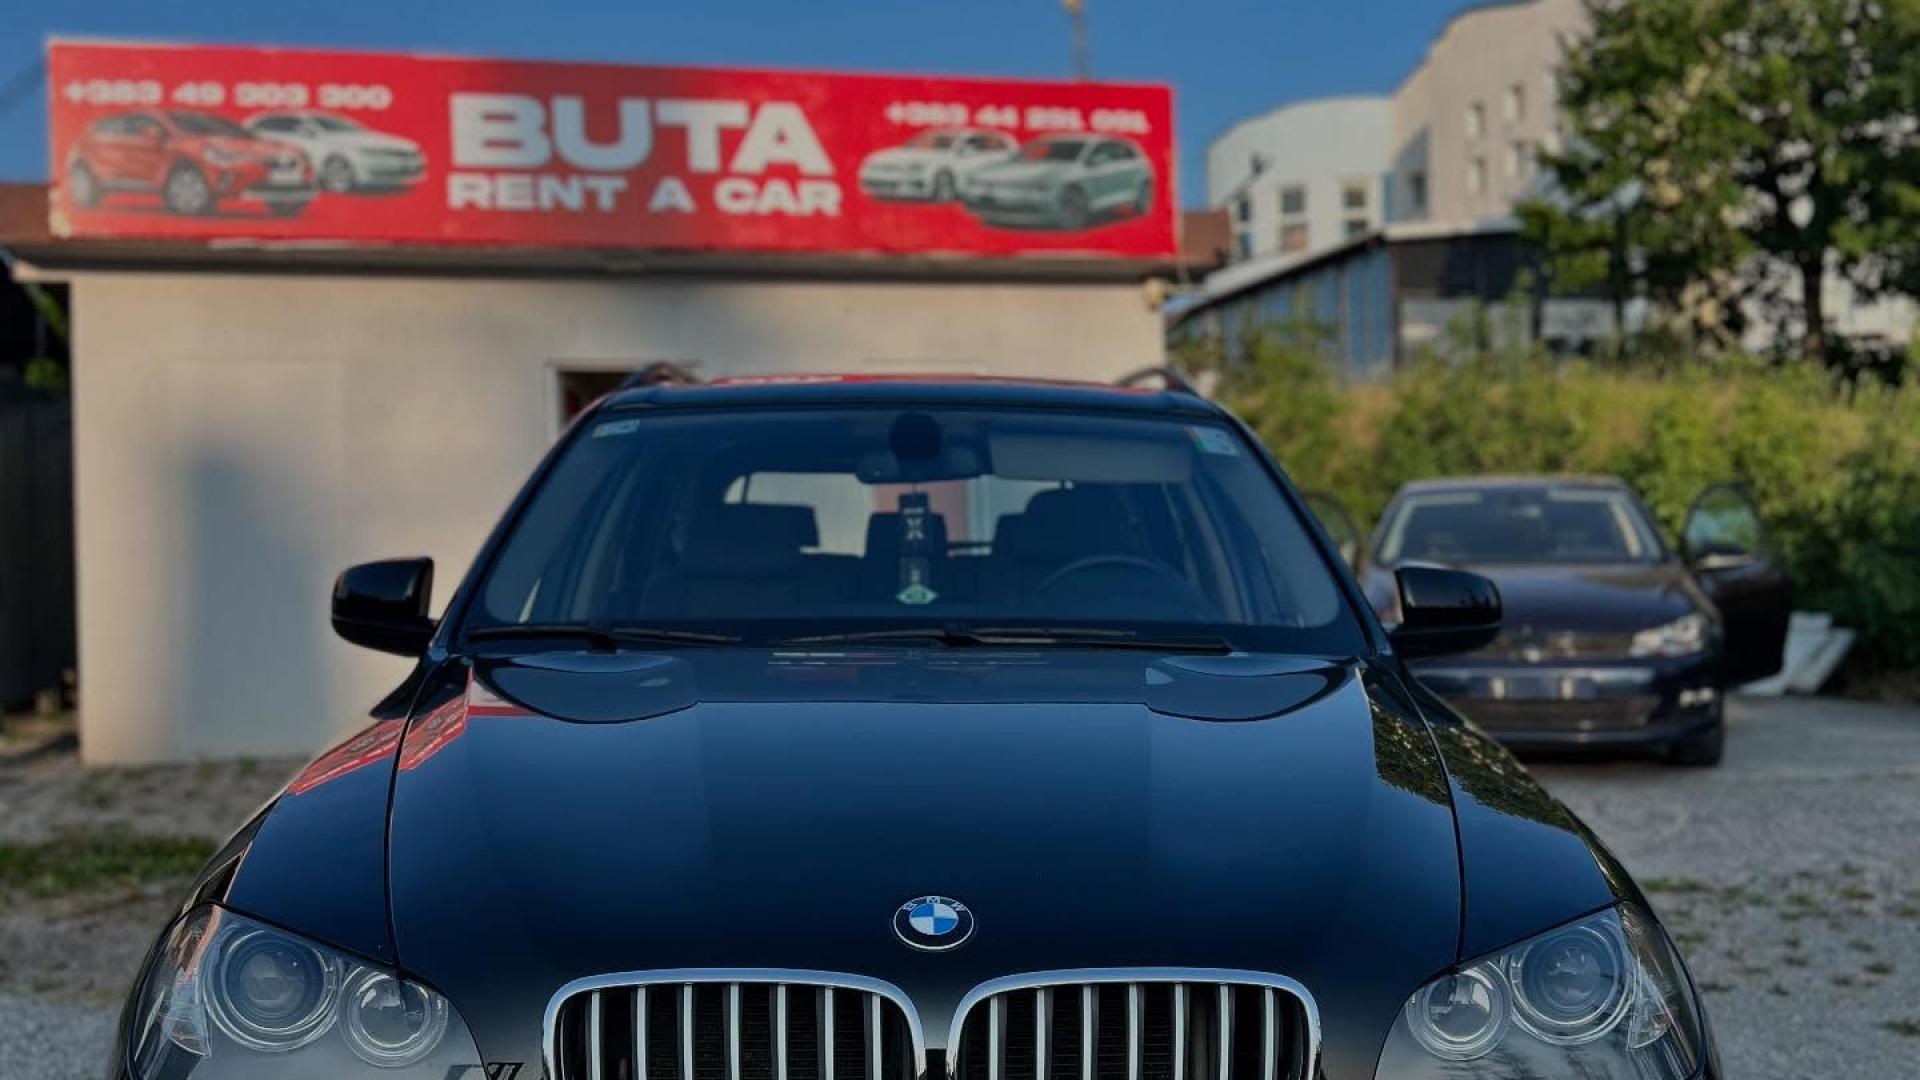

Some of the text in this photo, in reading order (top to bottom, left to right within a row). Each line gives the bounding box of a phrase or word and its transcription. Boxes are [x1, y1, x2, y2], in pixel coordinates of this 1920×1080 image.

[975, 104, 1019, 128] 44
[449, 93, 834, 176] BUTA
[447, 173, 843, 216] RENT A CAR
[903, 896, 968, 911] BMW
